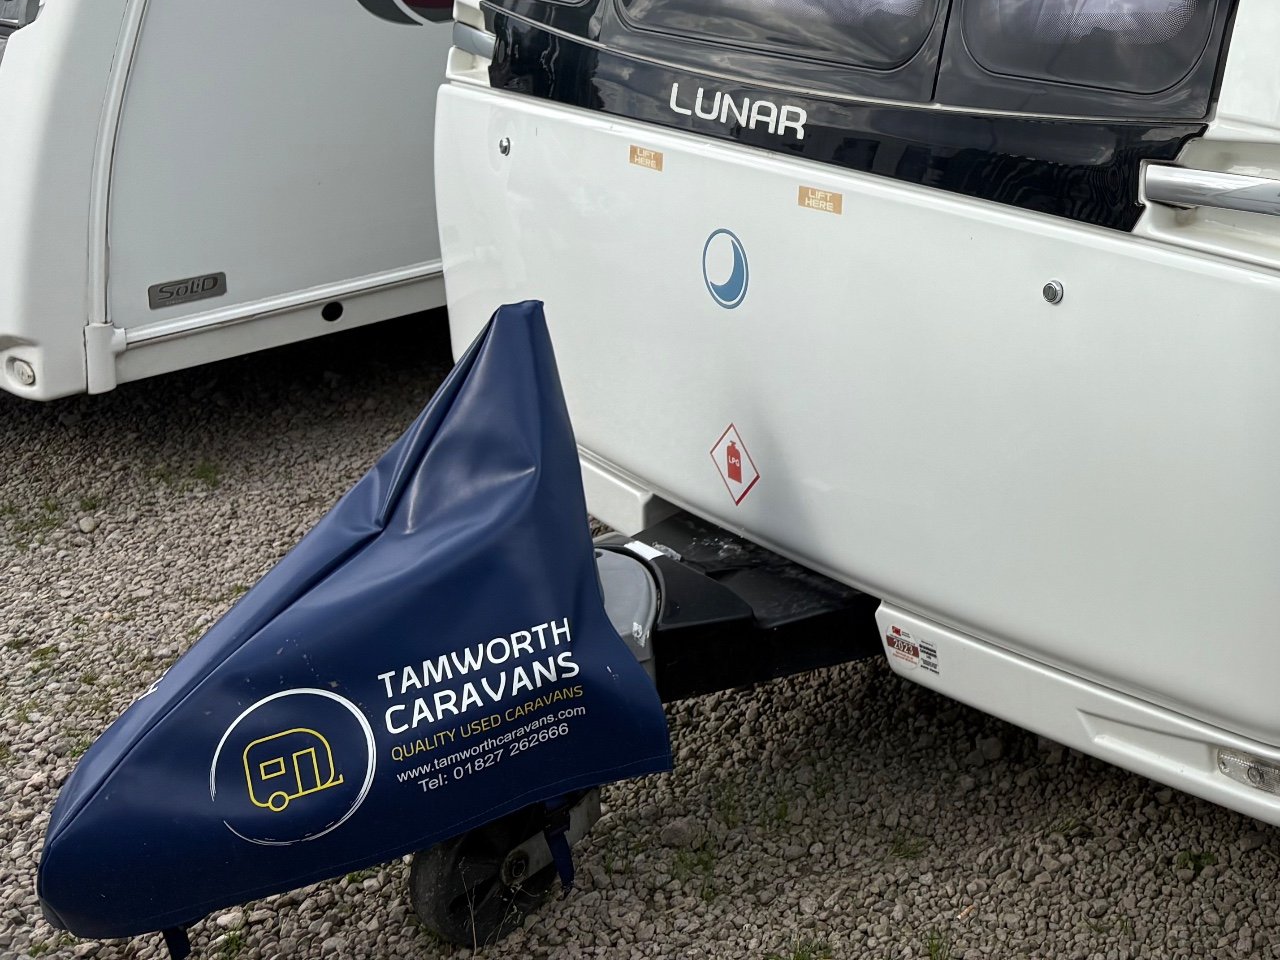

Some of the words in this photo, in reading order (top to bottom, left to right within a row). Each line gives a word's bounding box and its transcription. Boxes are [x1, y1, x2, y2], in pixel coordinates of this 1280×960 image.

[669, 82, 808, 141] LUNAR
[634, 155, 657, 169] HERE
[637, 147, 656, 158] LIFT
[804, 196, 835, 212] HERE
[808, 188, 833, 202] LIFT
[377, 617, 572, 699] TAMWORTH
[384, 651, 581, 735] CARAVANS
[391, 728, 456, 762] QUALITY
[460, 713, 501, 738] USED
[505, 685, 584, 722] CARAVANS
[396, 705, 587, 783] www.tamworthcaravans.com
[417, 773, 449, 793] Tel:
[453, 749, 504, 780] 01827
[509, 722, 570, 757] 262666
